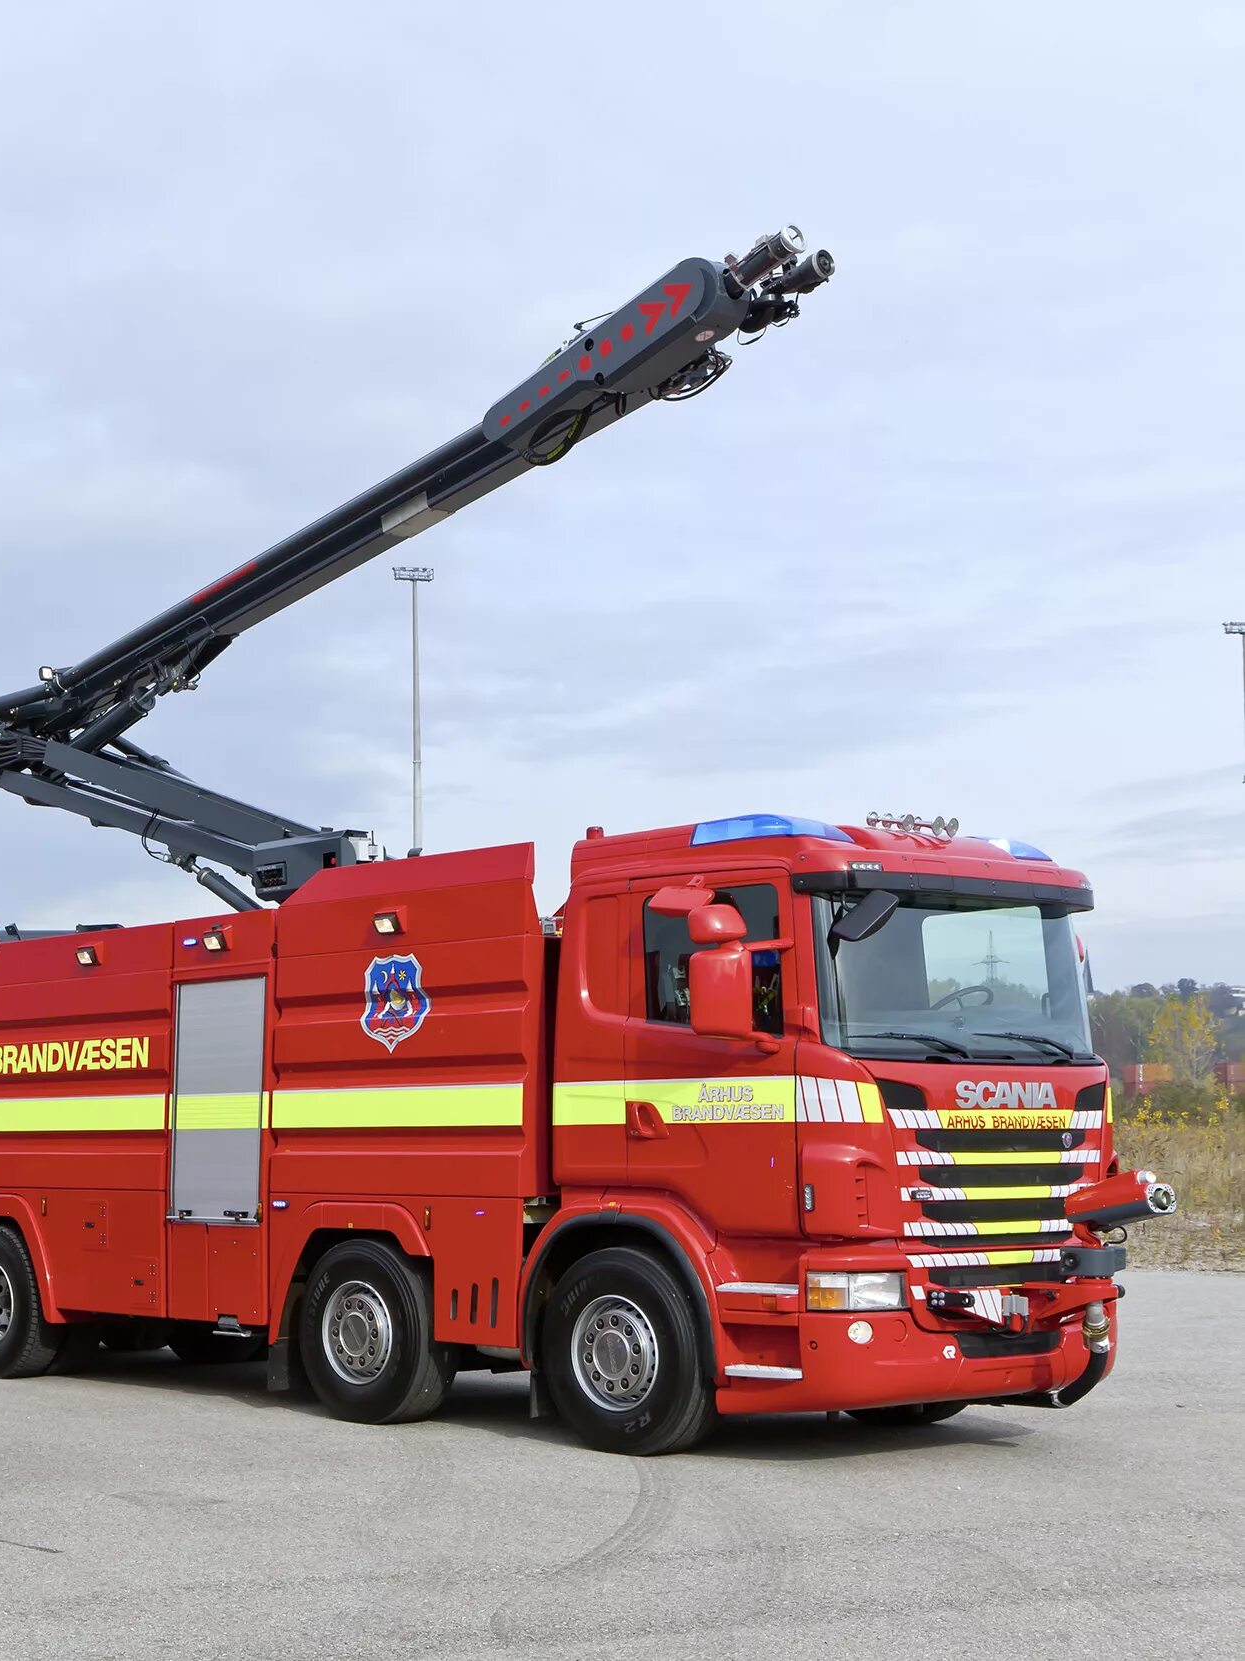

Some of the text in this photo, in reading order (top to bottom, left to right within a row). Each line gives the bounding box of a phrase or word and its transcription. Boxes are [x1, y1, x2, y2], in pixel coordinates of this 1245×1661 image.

[698, 1083, 754, 1103] ÅRHUS
[955, 1080, 1058, 1109] SCANIA
[671, 1103, 785, 1121] BRANDVÆSEN
[991, 1114, 1067, 1129] BRANDVÆSEN
